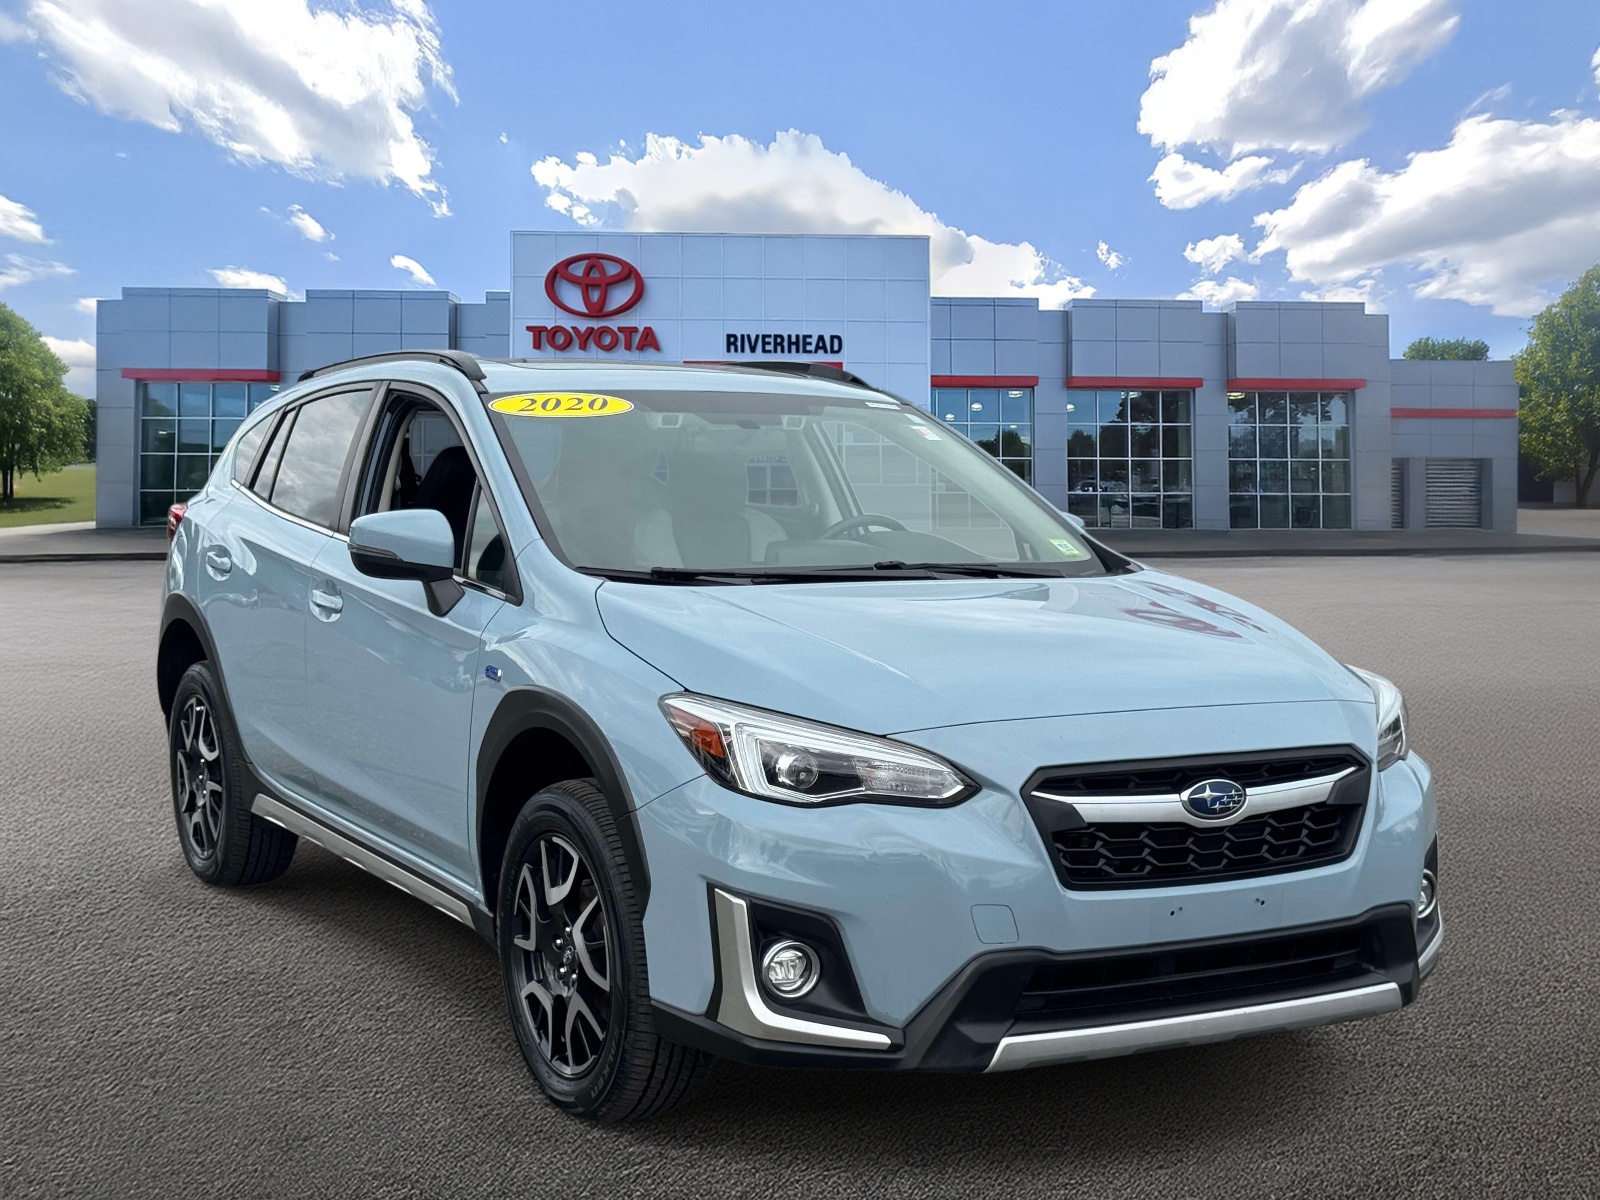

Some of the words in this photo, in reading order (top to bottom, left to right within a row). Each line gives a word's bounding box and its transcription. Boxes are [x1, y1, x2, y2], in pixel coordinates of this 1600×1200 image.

[526, 325, 661, 351] TOYOTA
[726, 333, 843, 354] RIVERHEAD
[517, 397, 609, 412] 2020
